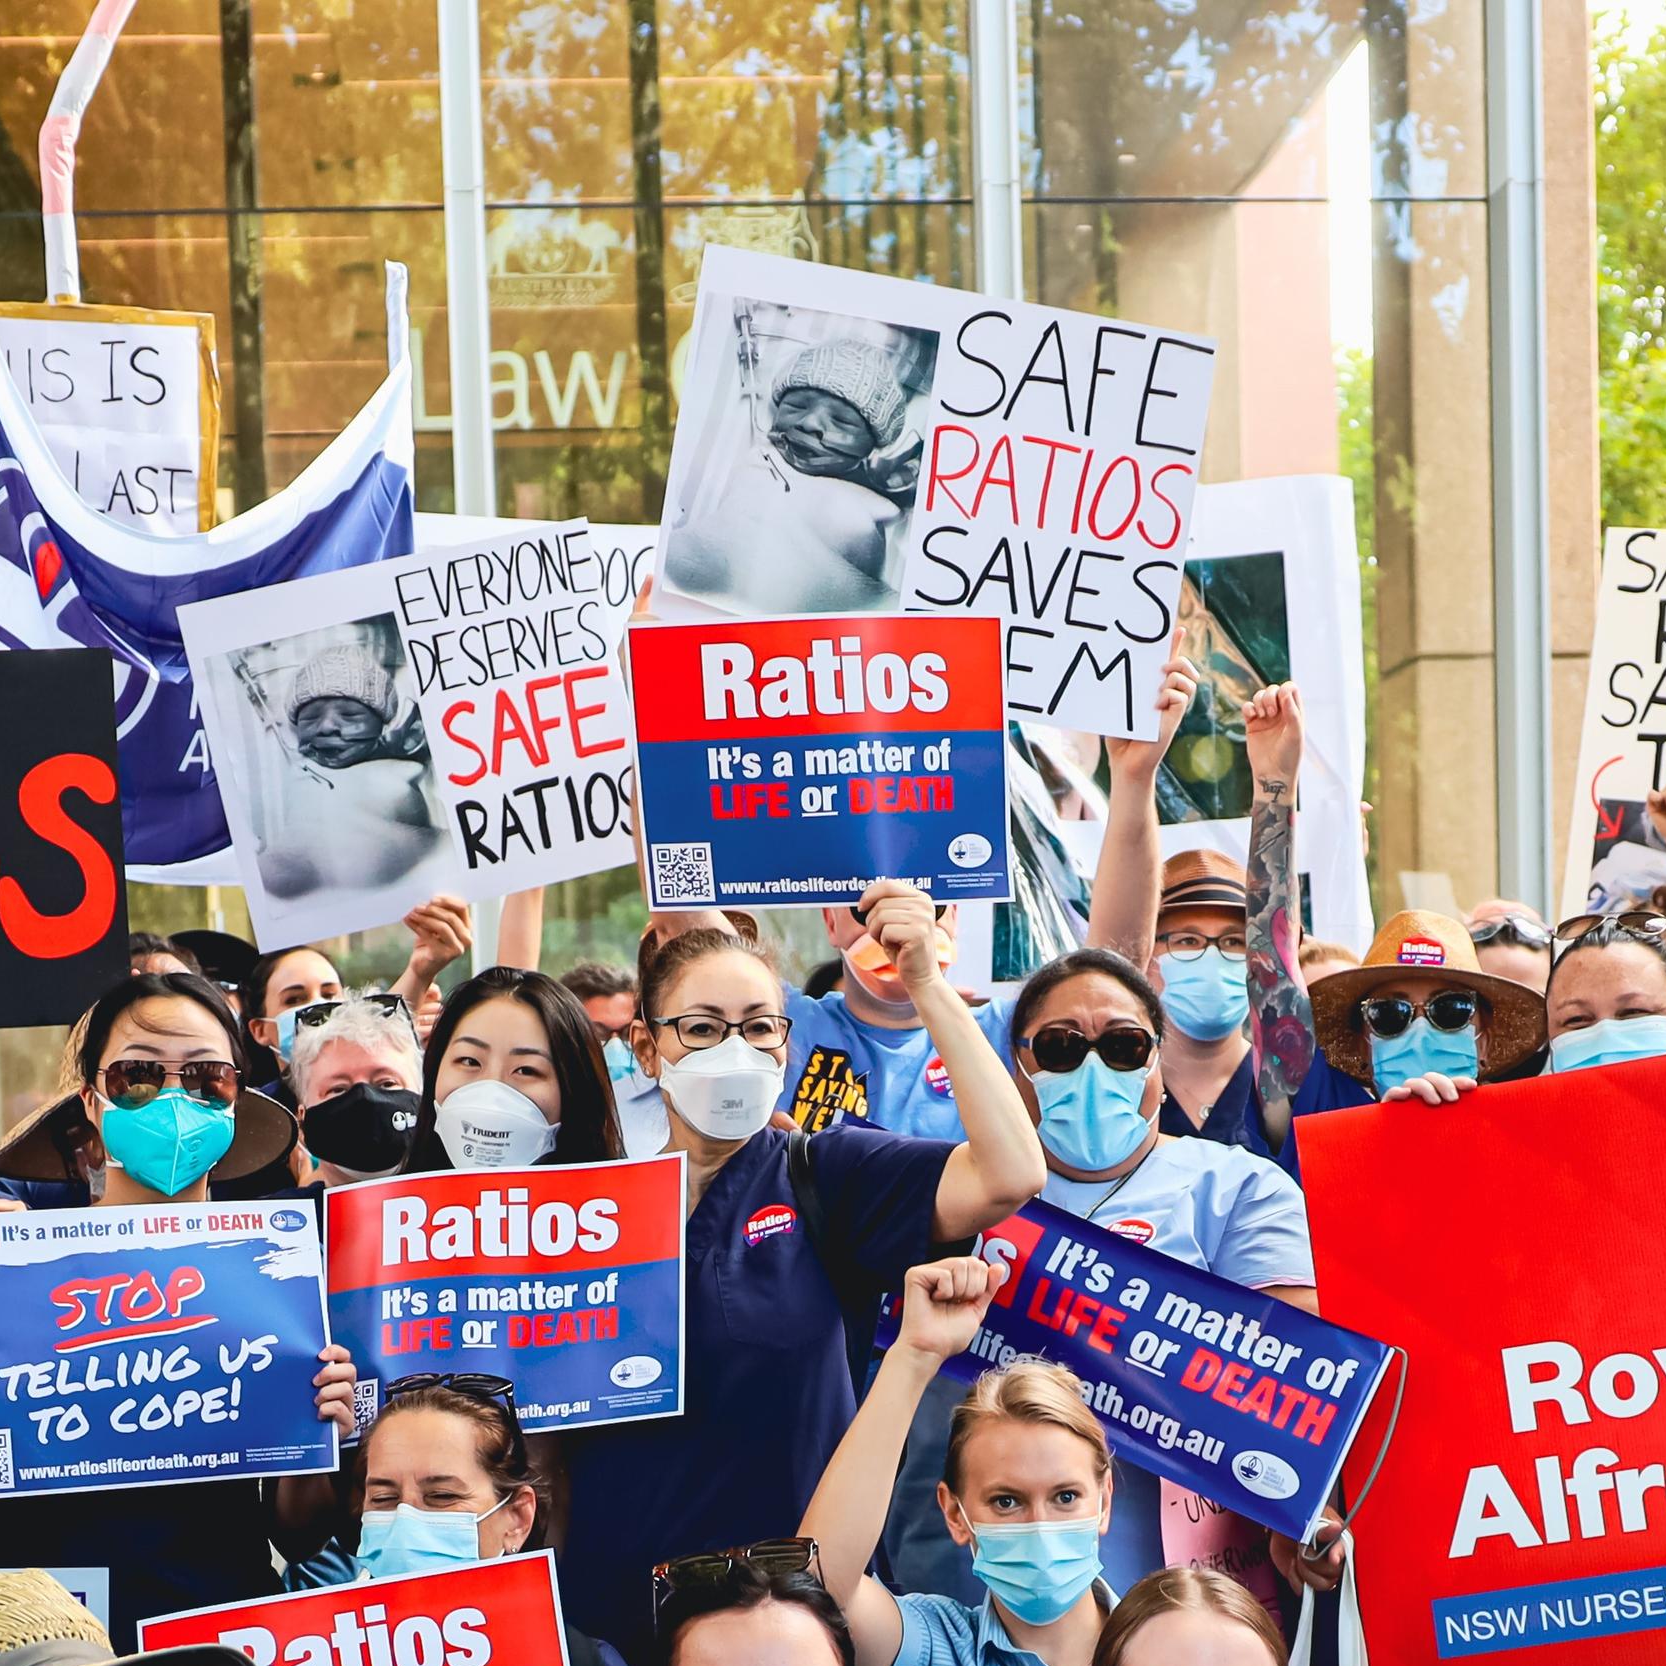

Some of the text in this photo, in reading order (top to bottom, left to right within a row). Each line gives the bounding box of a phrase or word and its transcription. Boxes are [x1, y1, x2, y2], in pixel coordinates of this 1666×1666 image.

[101, 341, 164, 405] IS
[940, 310, 1214, 455] SAFE
[926, 424, 1192, 549] RATIOS
[396, 531, 600, 626] EVERYONE
[915, 526, 1178, 642] SAVES
[409, 602, 606, 695] DESERVES
[701, 636, 948, 721] Ratios
[442, 667, 625, 786] SAFE
[456, 767, 634, 869] RATIOS
[722, 1099, 743, 1108] 3M
[2, 1225, 30, 1242] It's
[36, 1226, 46, 1240] a
[52, 1222, 112, 1239] matter
[117, 1218, 134, 1236] of
[144, 1217, 180, 1233] LIFE
[186, 1216, 202, 1231] or
[208, 1214, 263, 1231] DEATH
[748, 1213, 791, 1233] Ratios
[50, 1266, 205, 1330] STOP
[219, 1334, 279, 1375] US
[29, 1377, 241, 1445] TO COPE!
[19, 1450, 239, 1480] www.ratioslifeordeath.org.au
[1444, 1604, 1529, 1650] NSW
